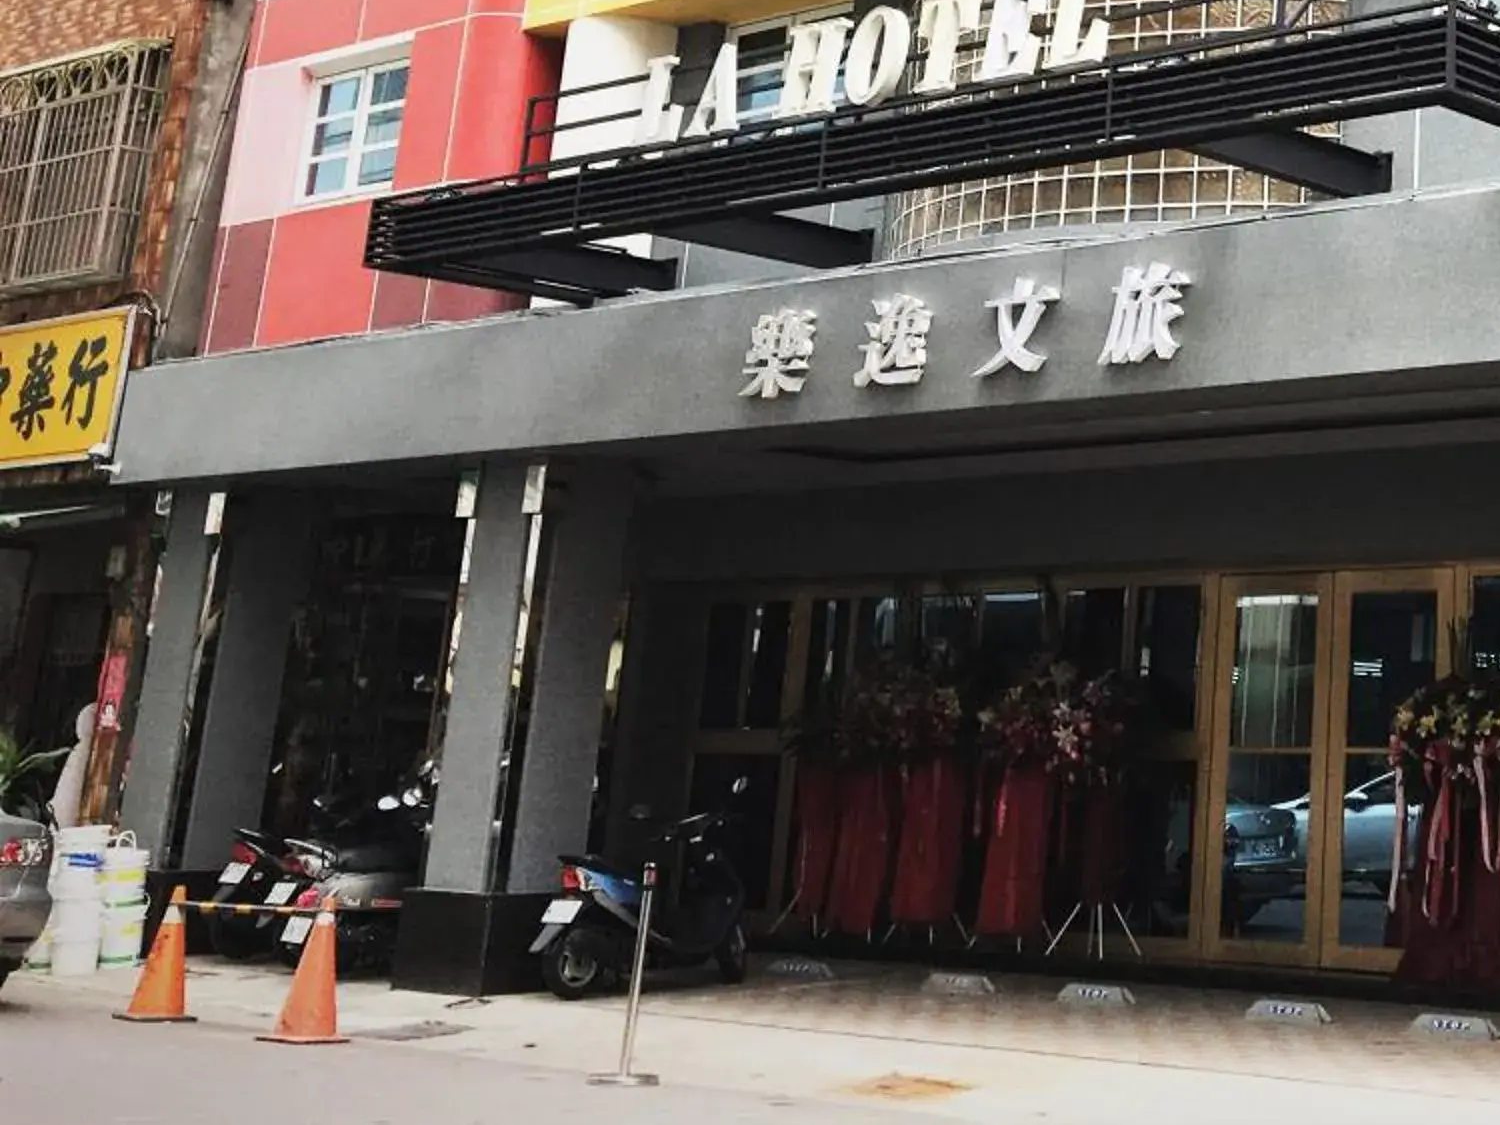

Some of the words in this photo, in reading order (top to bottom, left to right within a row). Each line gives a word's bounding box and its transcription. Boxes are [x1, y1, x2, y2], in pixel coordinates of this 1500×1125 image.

[635, 43, 740, 145] LA
[738, 261, 1193, 399] 樂逸文旅
